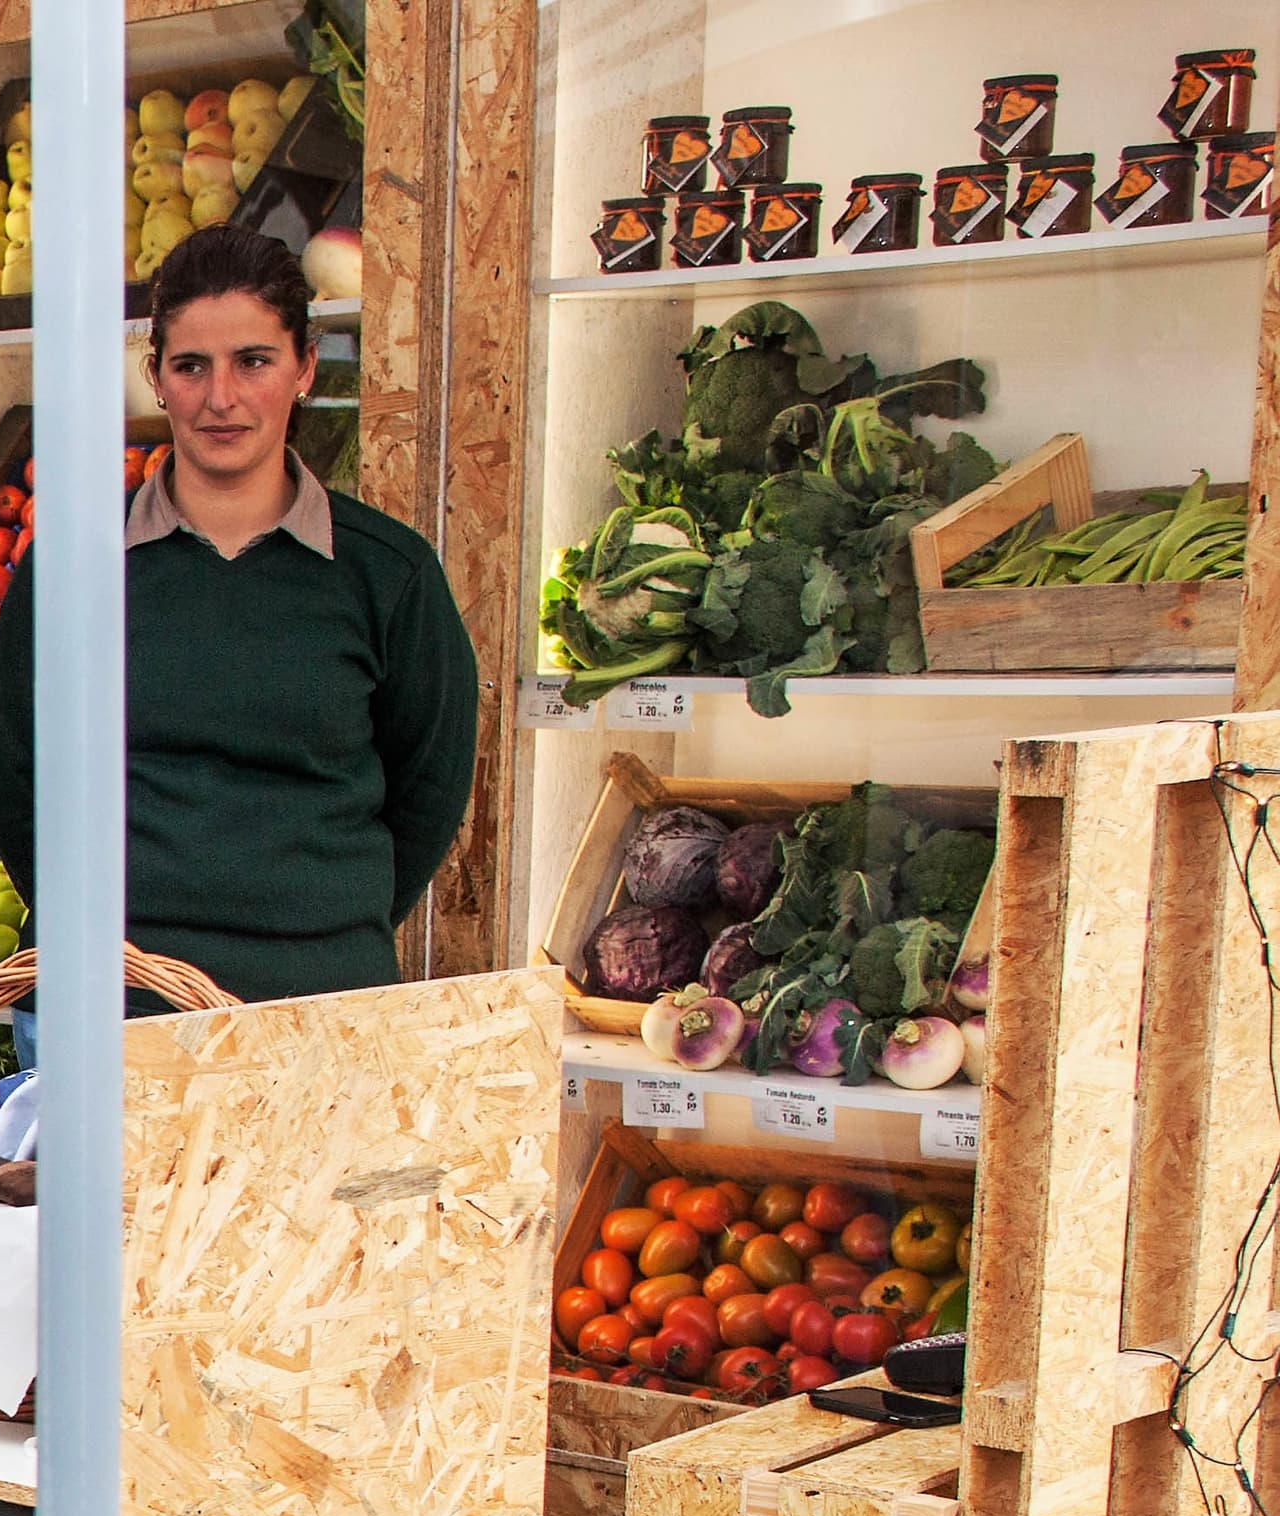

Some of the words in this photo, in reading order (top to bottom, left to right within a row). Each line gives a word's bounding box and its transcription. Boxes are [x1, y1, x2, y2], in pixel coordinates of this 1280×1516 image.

[638, 705, 657, 717] 1.20
[652, 1103, 671, 1114] 1.30
[782, 1113, 801, 1125] 1.20
[955, 1135, 975, 1147] 1.70
